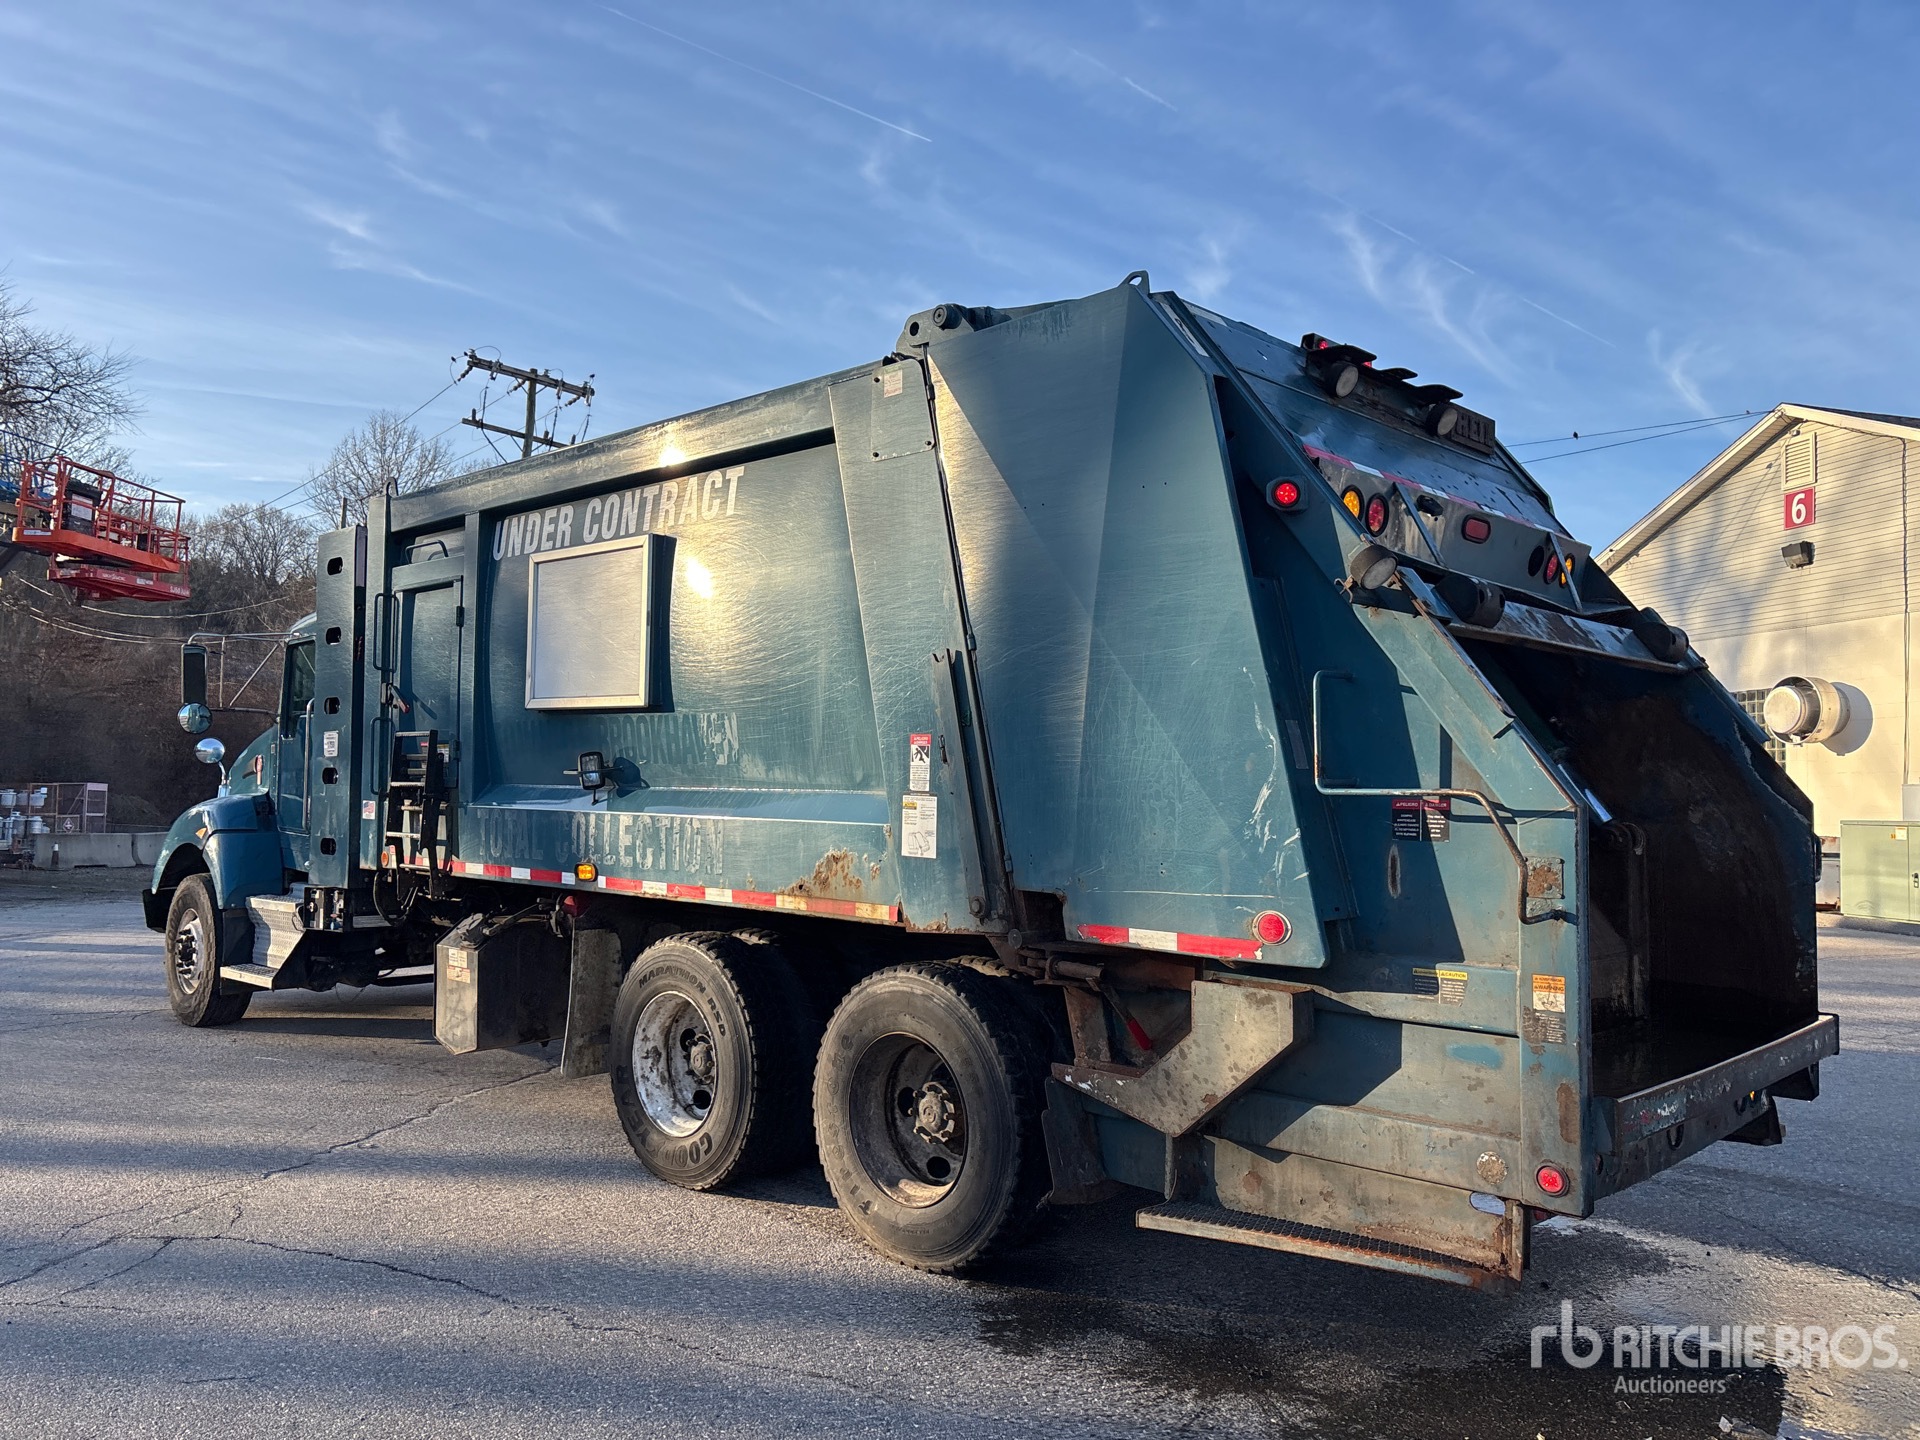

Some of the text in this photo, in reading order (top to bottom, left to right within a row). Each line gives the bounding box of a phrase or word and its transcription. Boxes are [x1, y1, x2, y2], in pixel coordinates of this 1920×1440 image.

[492, 466, 745, 561] UNDER CONTRACT
[1791, 492, 1807, 525] 6
[550, 810, 724, 875] COLLECTION
[639, 965, 727, 1037] MARATHON RSD
